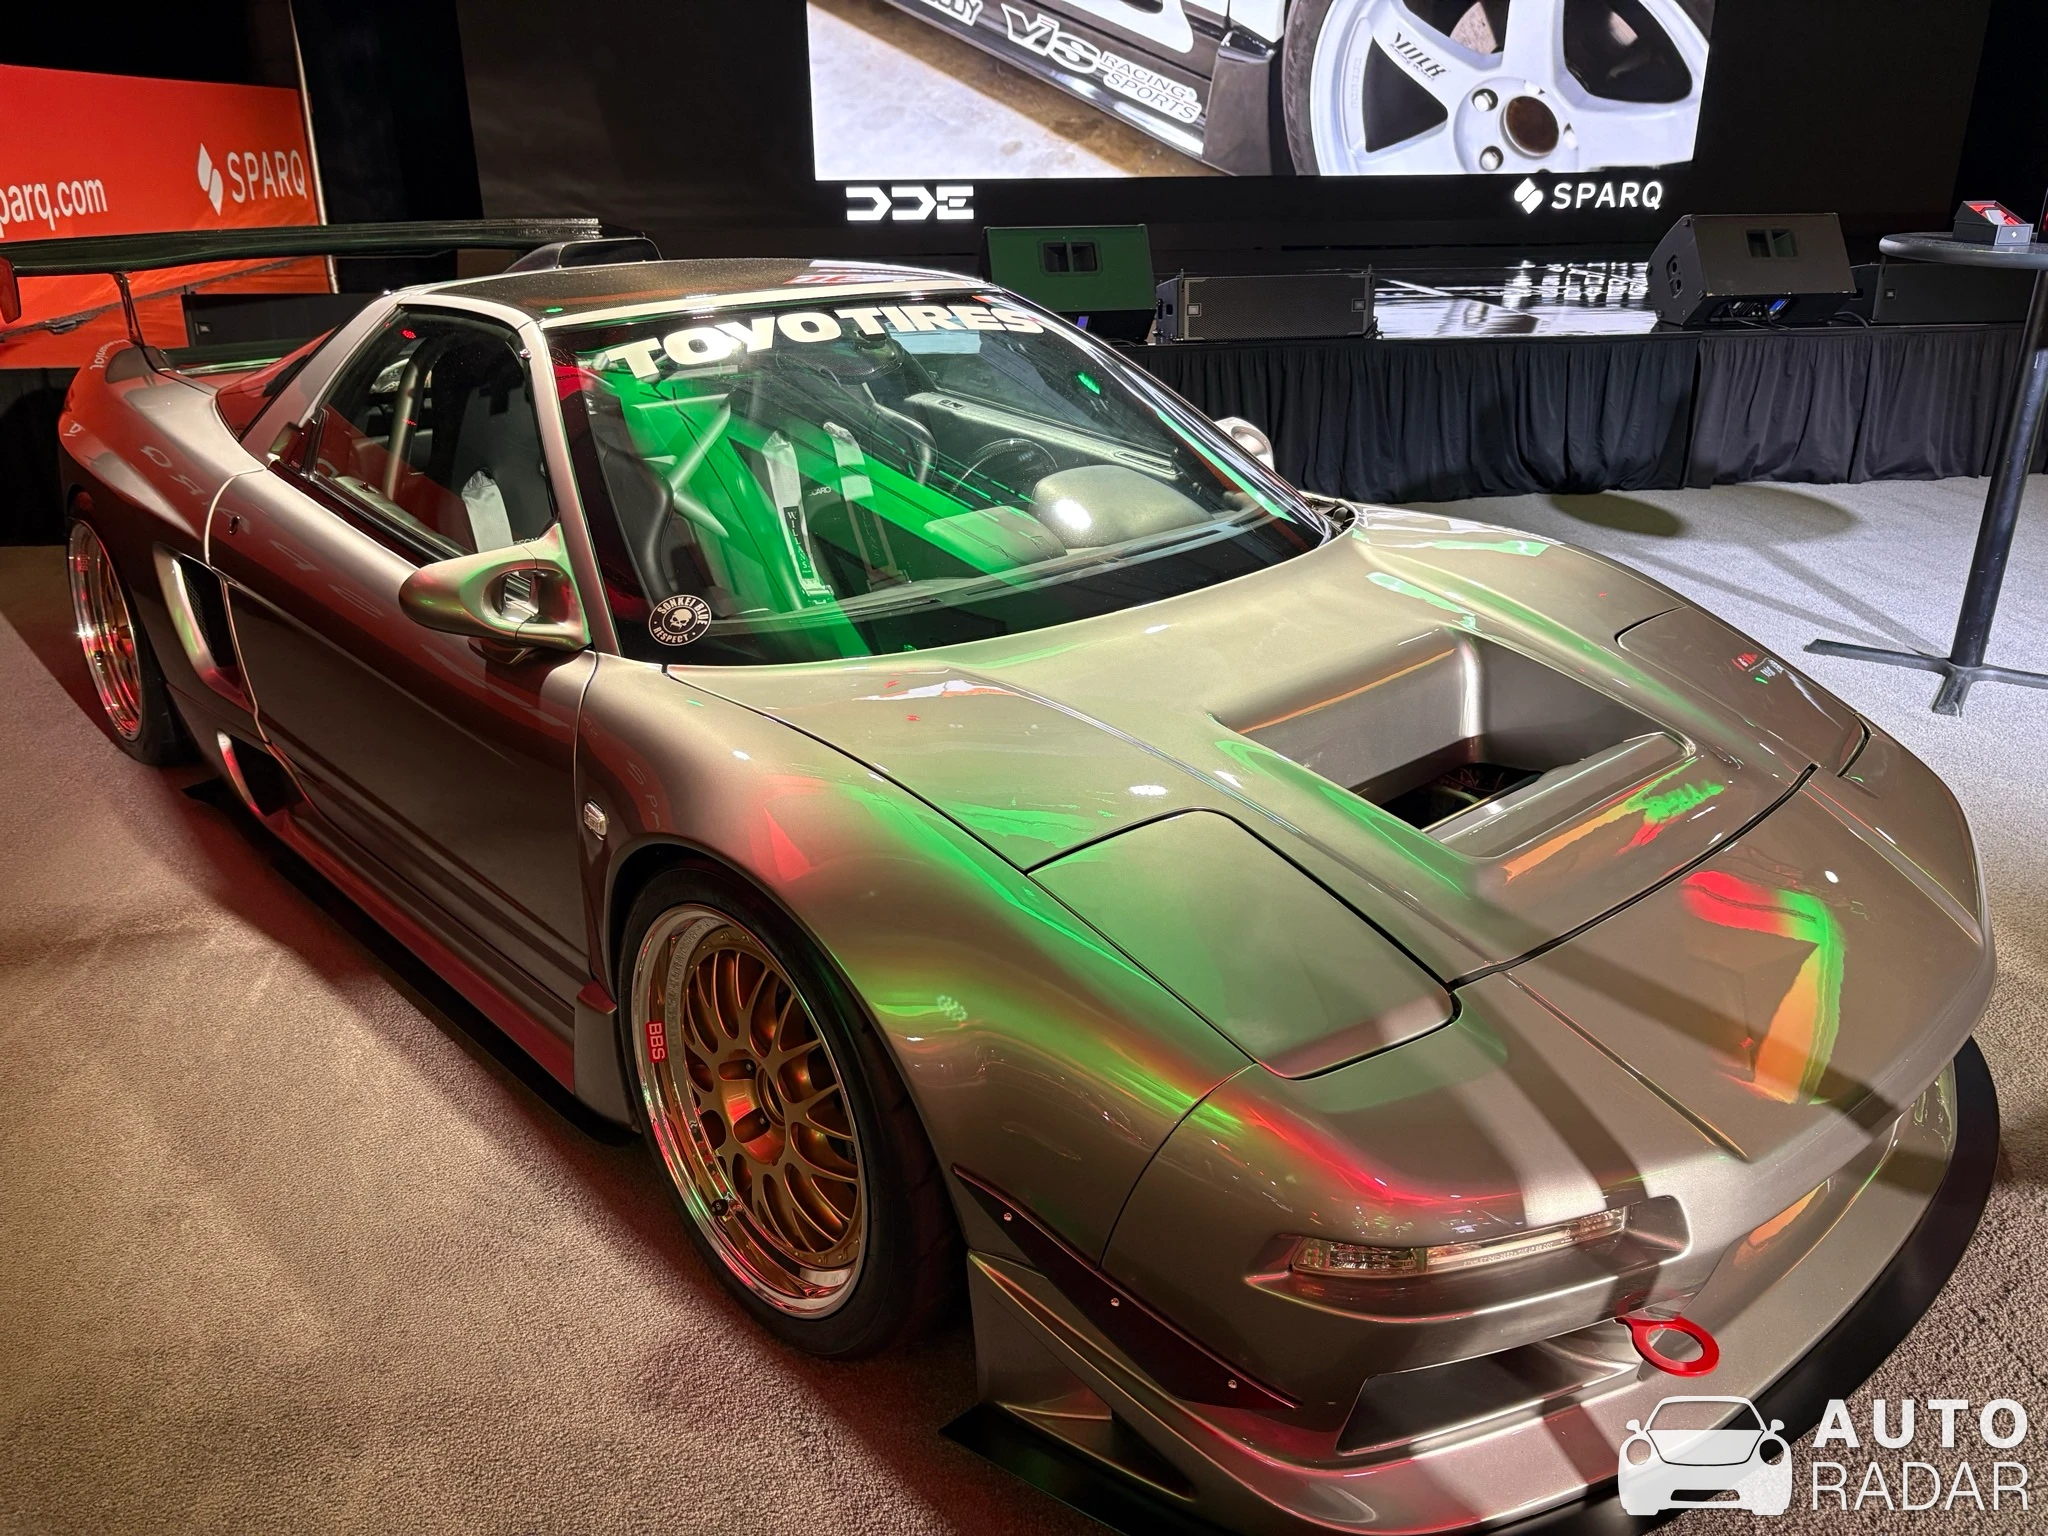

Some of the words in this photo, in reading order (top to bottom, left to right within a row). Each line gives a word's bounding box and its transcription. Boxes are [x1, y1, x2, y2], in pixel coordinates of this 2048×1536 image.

[1103, 55, 1187, 99] RACING
[1107, 73, 1196, 119] SPORTS
[227, 149, 307, 203] SPARQ
[845, 186, 975, 221] DDE
[1551, 181, 1663, 210] SPARQ
[604, 311, 842, 379] TOYO
[836, 305, 1045, 335] TIRES
[657, 597, 697, 614] SONKEI
[694, 603, 709, 625] BLUE
[653, 626, 689, 643] RESPECT
[649, 1022, 666, 1060] BBS
